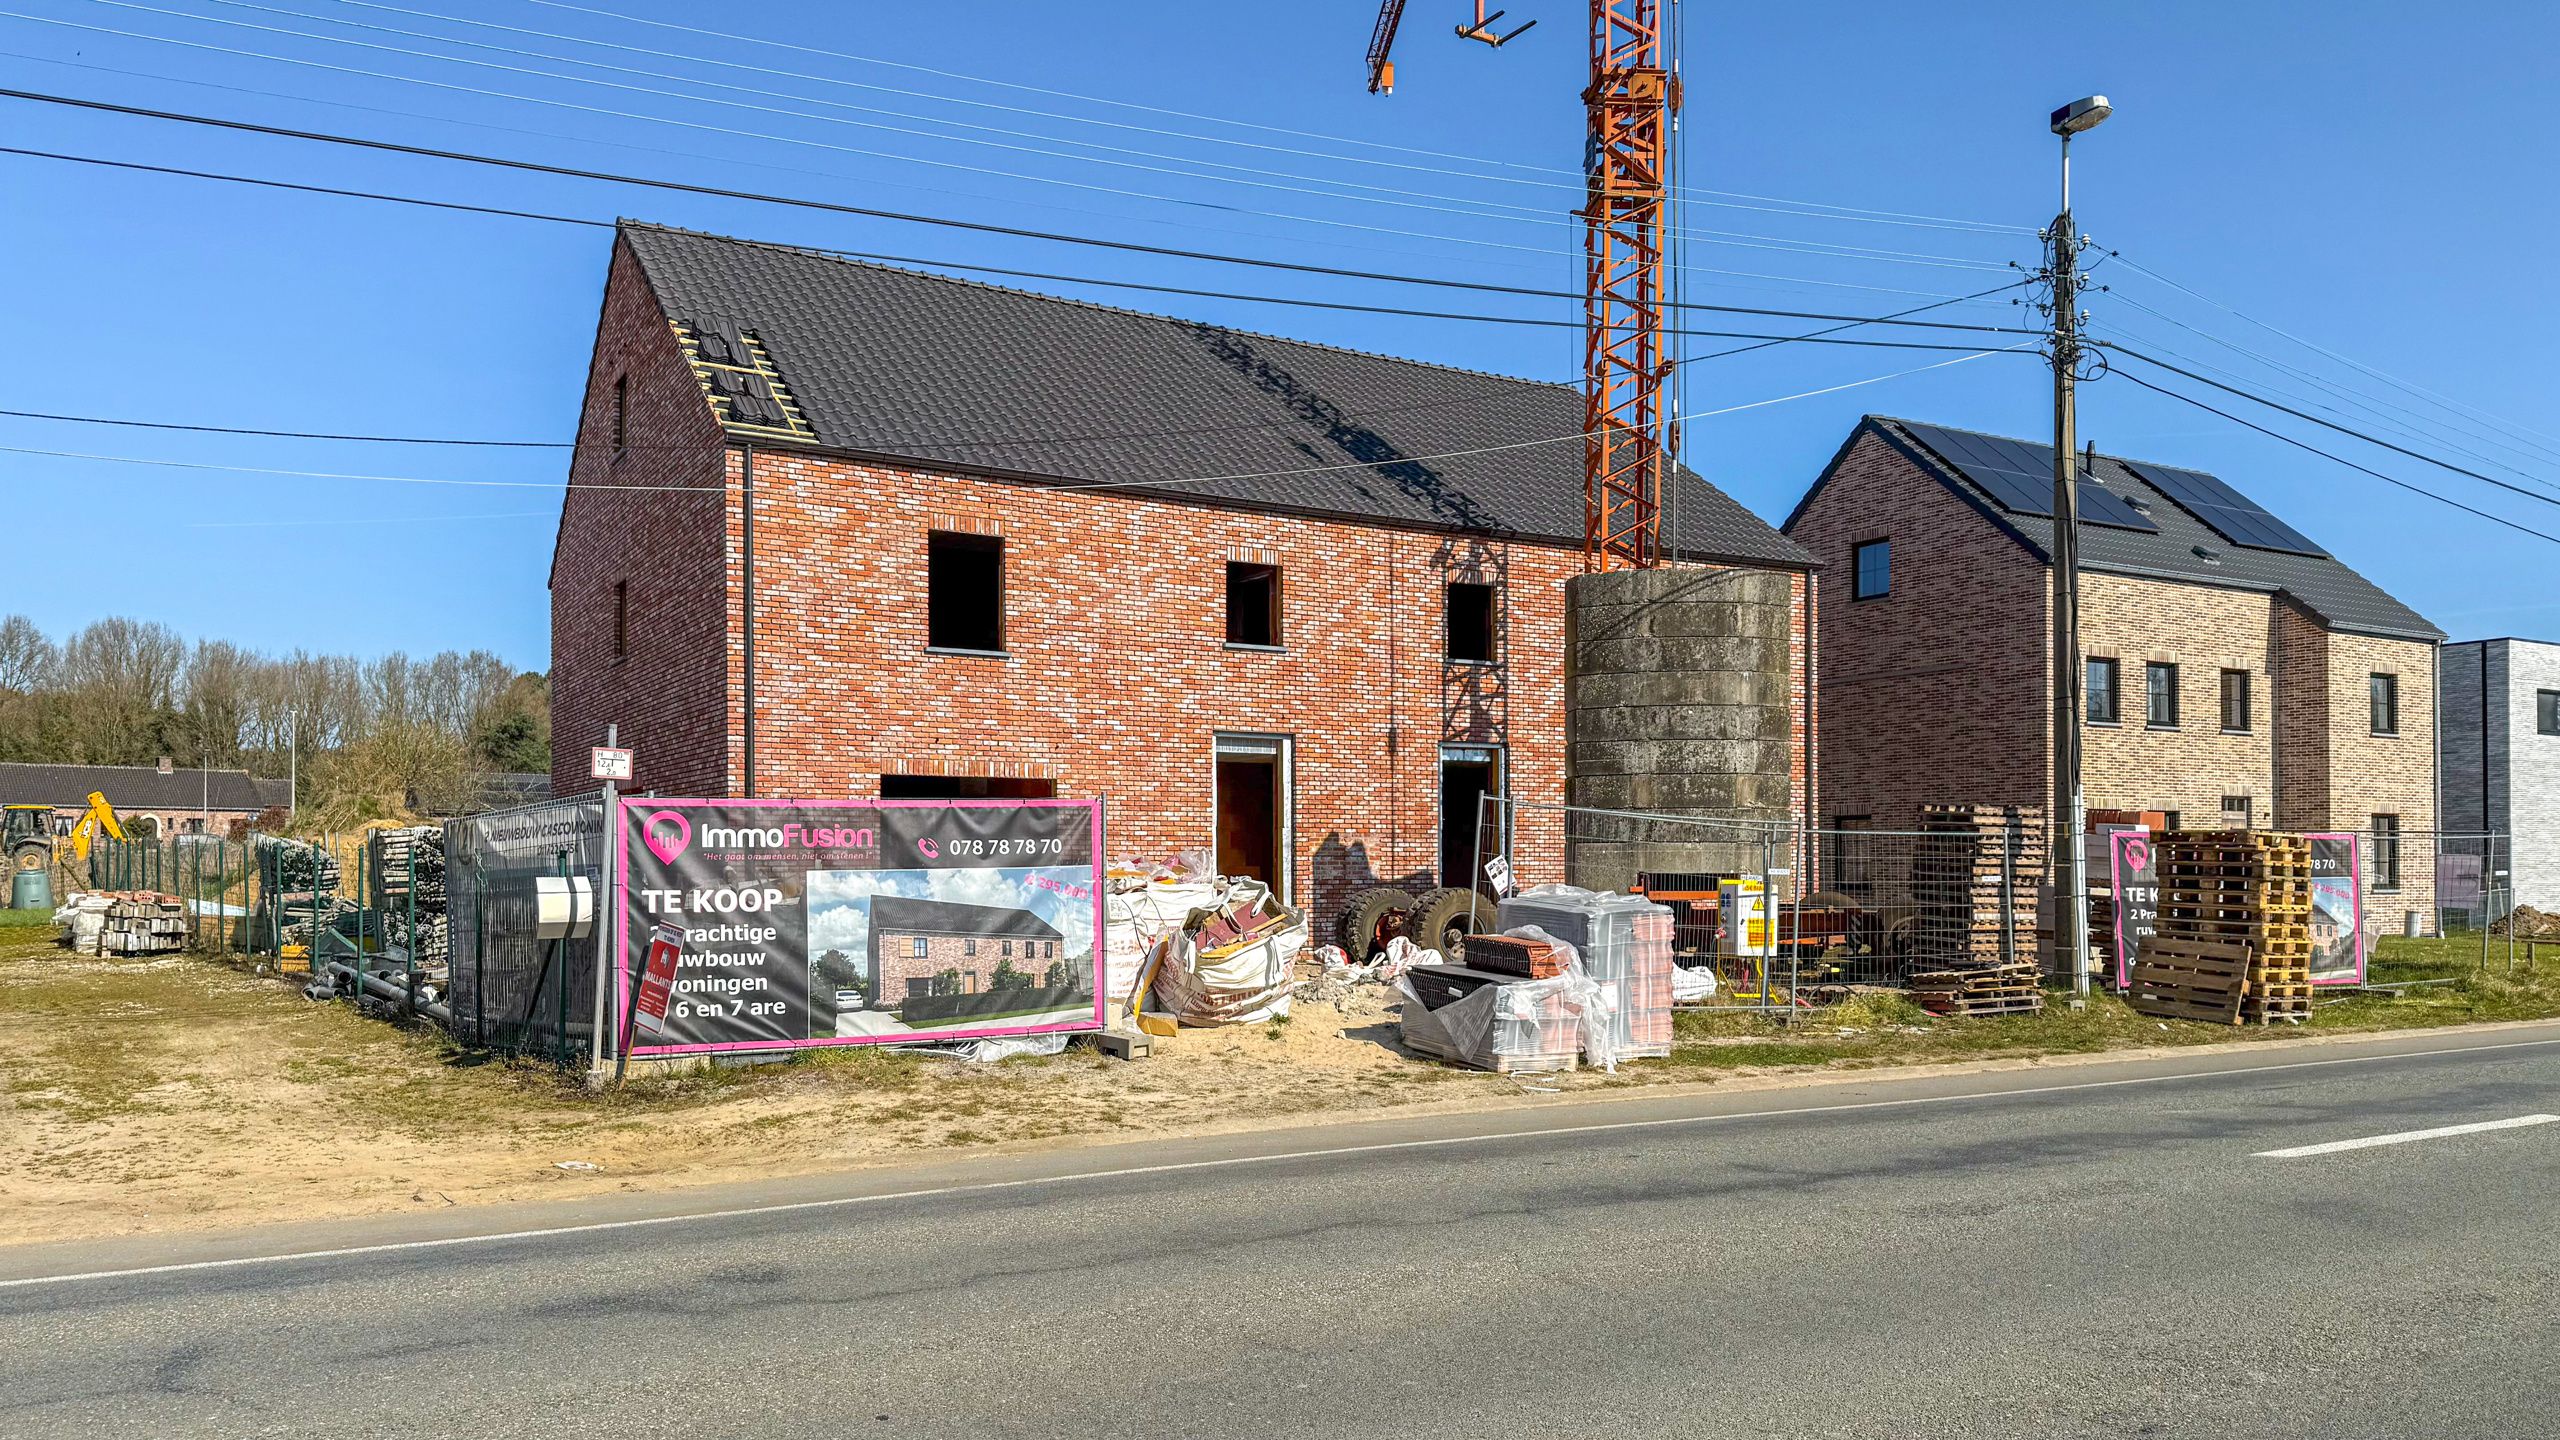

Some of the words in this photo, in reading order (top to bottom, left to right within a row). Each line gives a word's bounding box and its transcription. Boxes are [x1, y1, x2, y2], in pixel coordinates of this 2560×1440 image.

[701, 823, 873, 848] ImmoFusion
[949, 839, 984, 855] 078
[988, 839, 1010, 855] 78
[1014, 838, 1036, 854] 78
[1040, 838, 1062, 854] 70
[2322, 859, 2335, 870] 70
[641, 889, 682, 913] TE
[693, 888, 783, 914] KOOP
[2126, 887, 2145, 902] TE
[2130, 909, 2138, 920] 2
[685, 924, 777, 945] rachtige
[678, 950, 766, 968] wbouw
[672, 975, 768, 995] oningen
[675, 1001, 689, 1018] 6
[696, 1003, 723, 1017] en
[730, 1000, 743, 1016] 7
[750, 1001, 786, 1016] are
